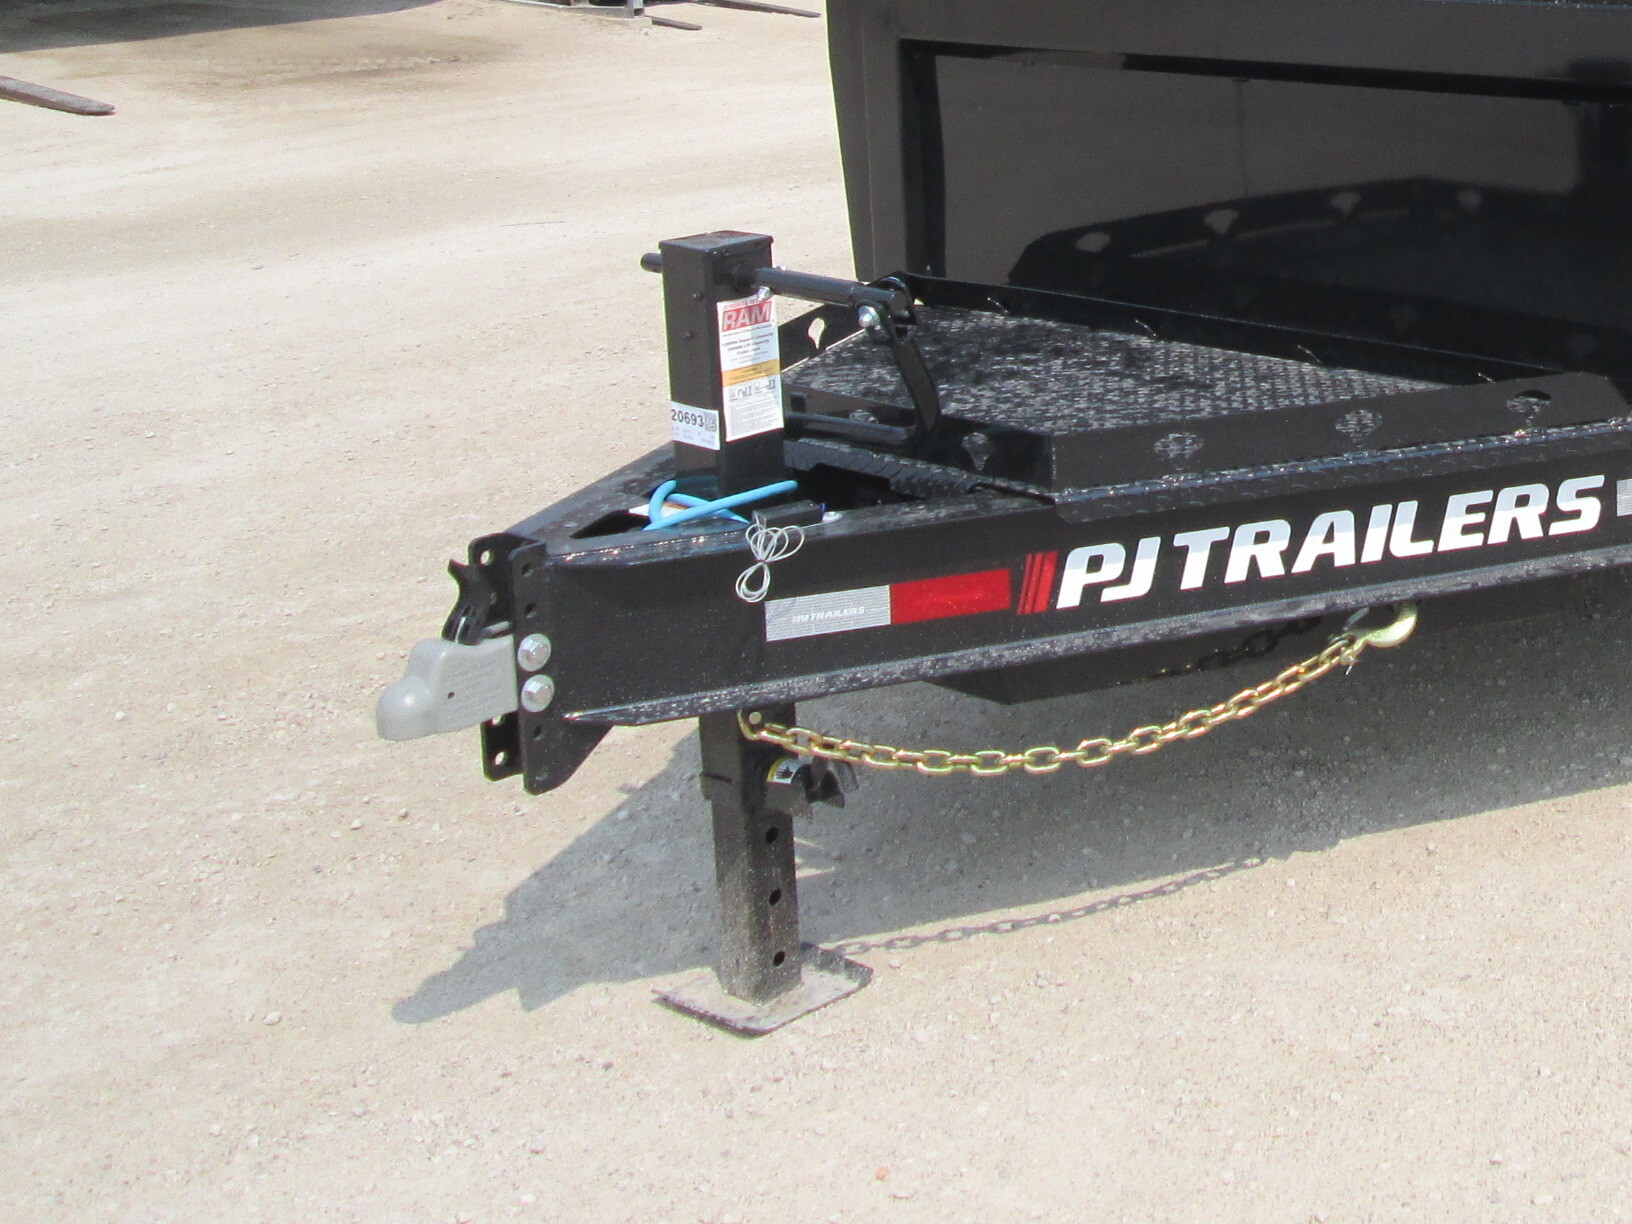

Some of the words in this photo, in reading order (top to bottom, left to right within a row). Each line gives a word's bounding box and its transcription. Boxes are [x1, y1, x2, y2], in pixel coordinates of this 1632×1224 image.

[723, 303, 771, 332] RAM
[671, 408, 704, 427] 20693
[1056, 536, 1161, 610] PJ
[1173, 475, 1605, 591] TRAILERS
[809, 605, 866, 620] TRAILERS
